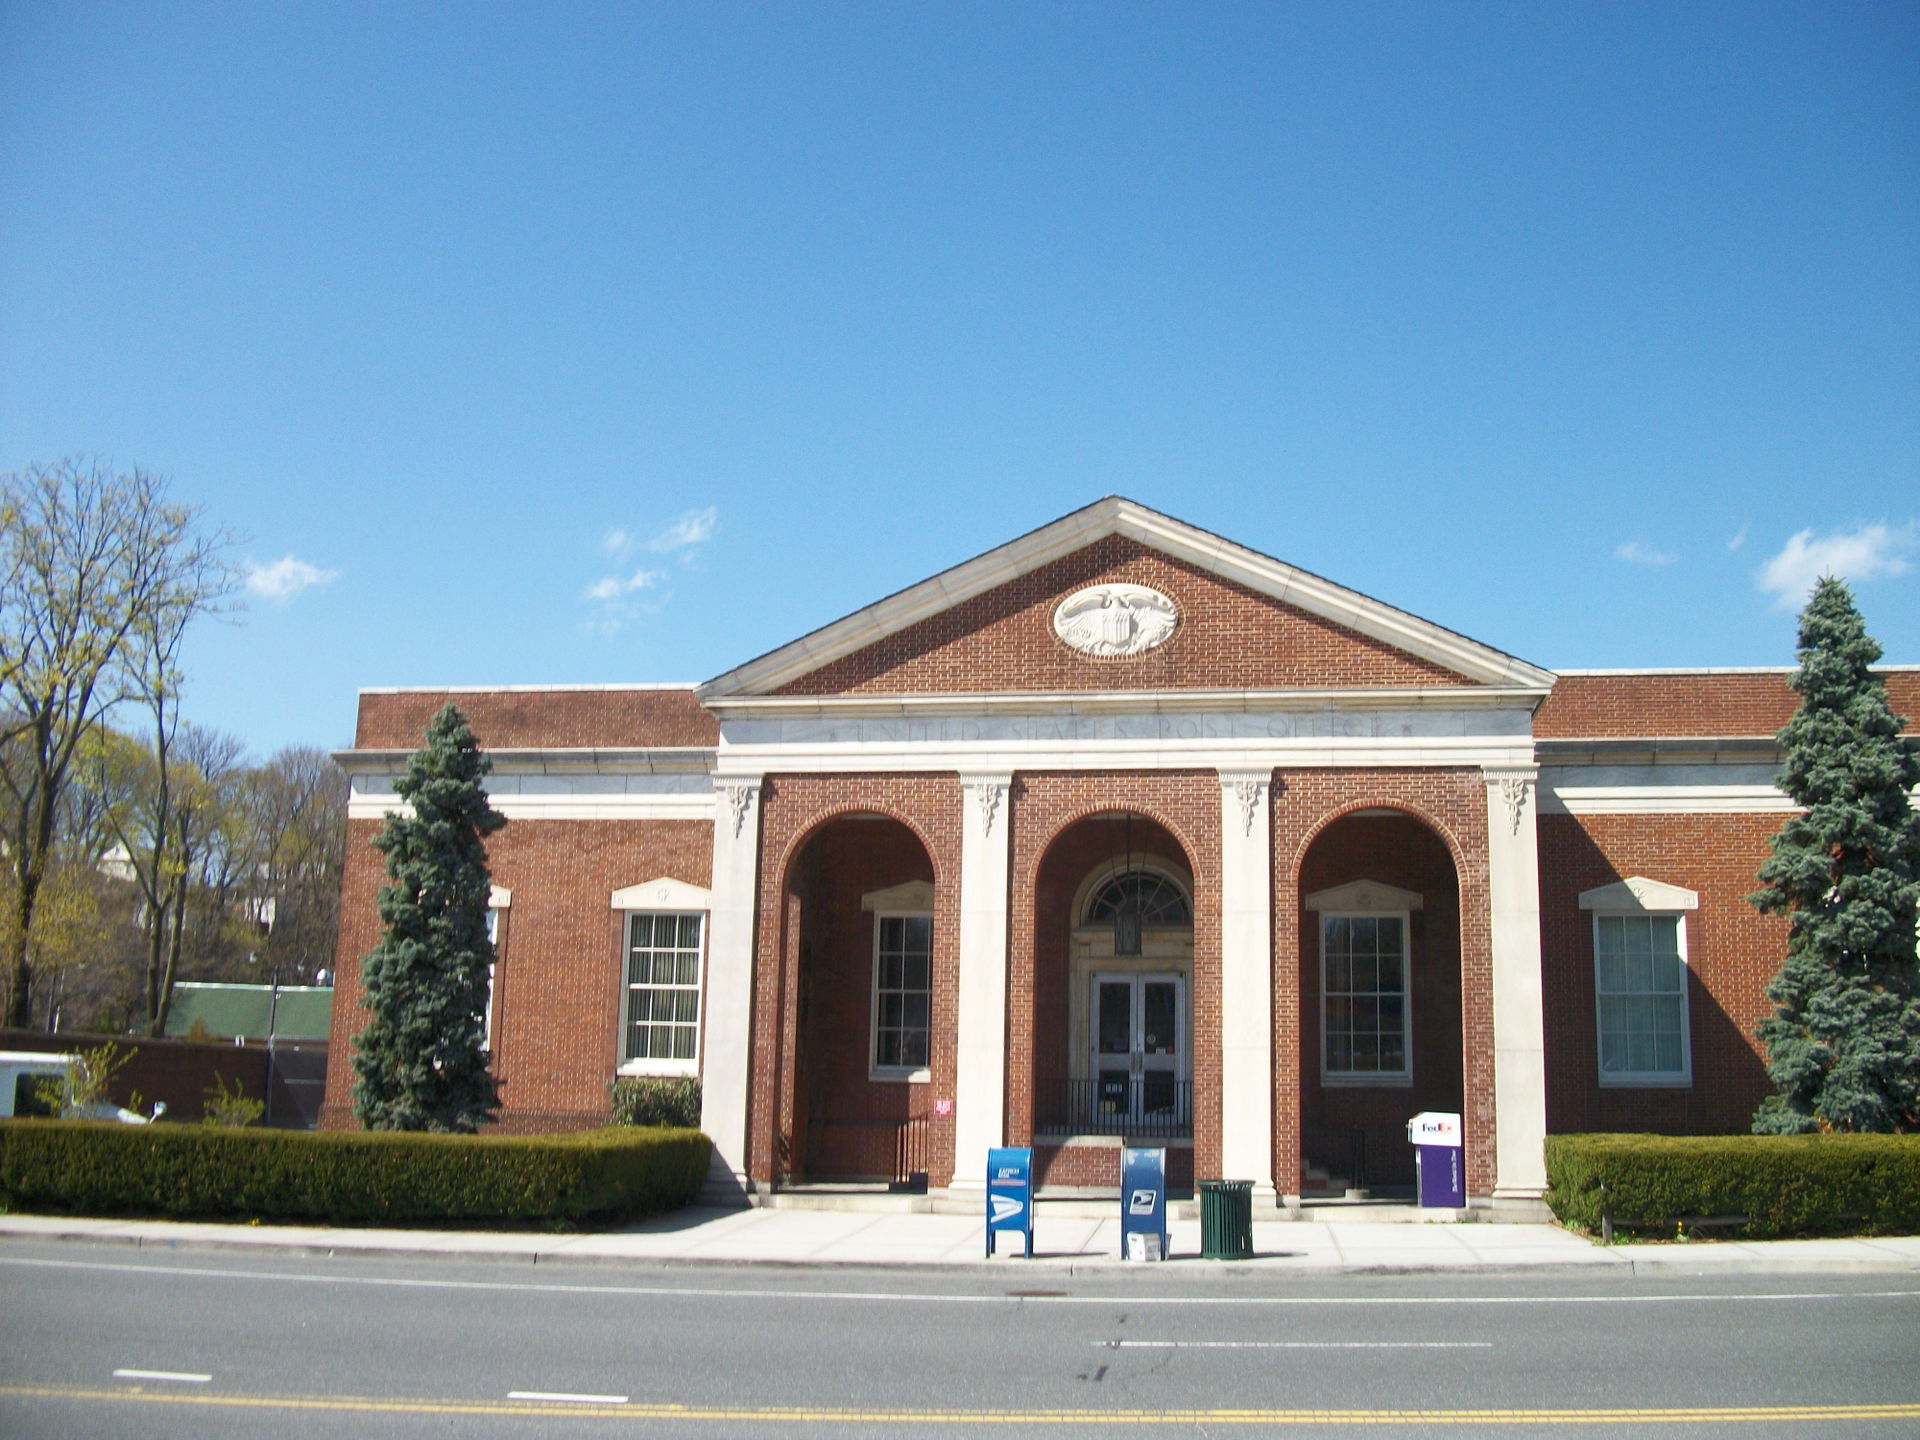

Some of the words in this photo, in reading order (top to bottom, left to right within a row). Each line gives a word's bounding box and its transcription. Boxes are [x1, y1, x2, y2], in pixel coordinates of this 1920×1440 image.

[856, 719, 981, 741] UNITED
[1011, 718, 1128, 740] STATES
[1158, 717, 1238, 739] POST
[1266, 716, 1386, 738] OFFICE
[1422, 1122, 1453, 1133] FedEx
